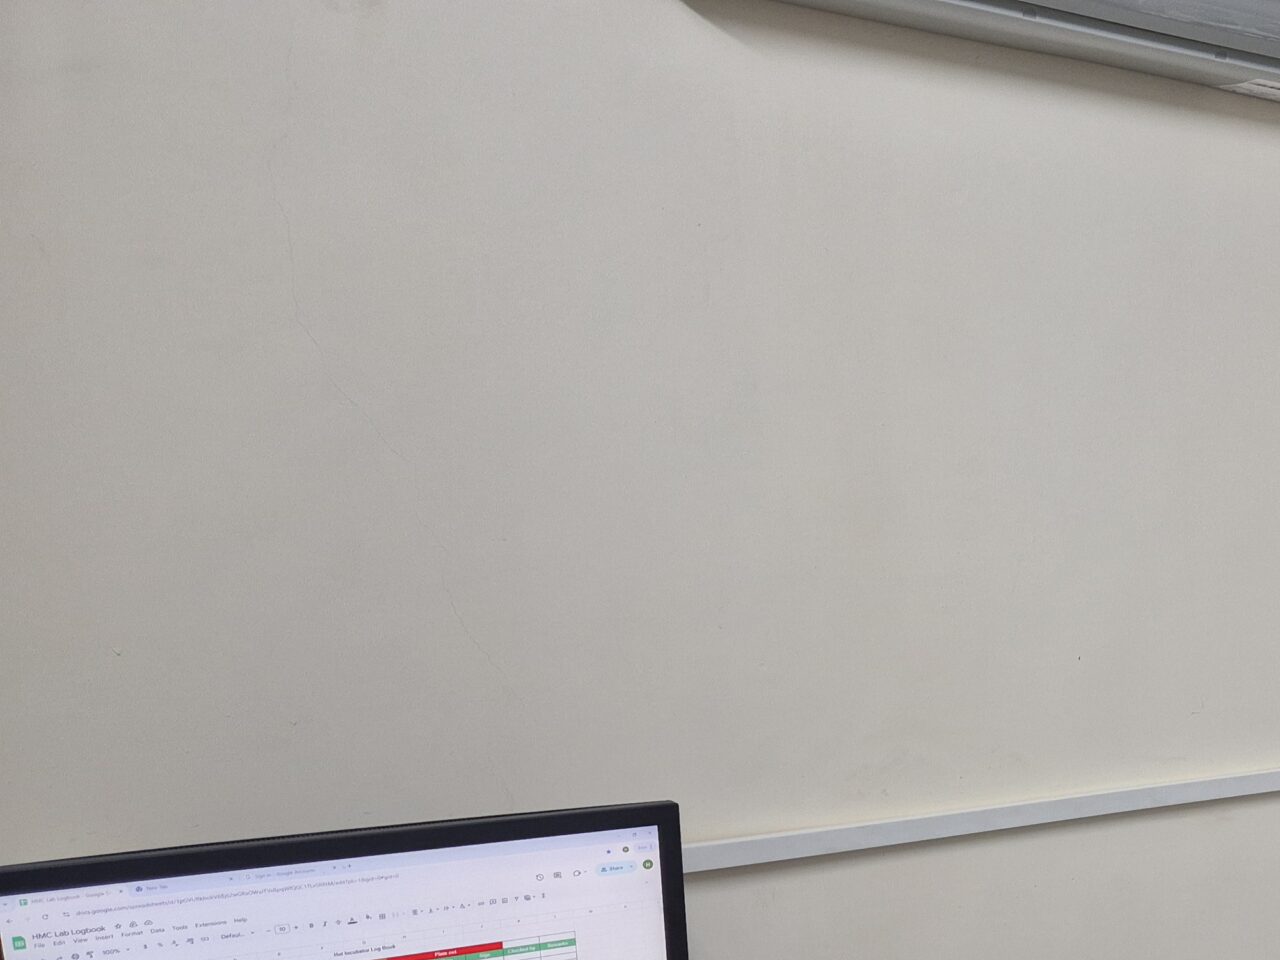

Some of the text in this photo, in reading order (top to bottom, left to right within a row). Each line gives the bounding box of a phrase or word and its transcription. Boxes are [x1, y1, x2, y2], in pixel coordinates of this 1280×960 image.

[31, 925, 106, 940] HMC Lab Logbook
[53, 939, 66, 947] Edit
[95, 933, 115, 941] Insert
[121, 930, 144, 938] Format
[195, 918, 228, 929] Extensions
